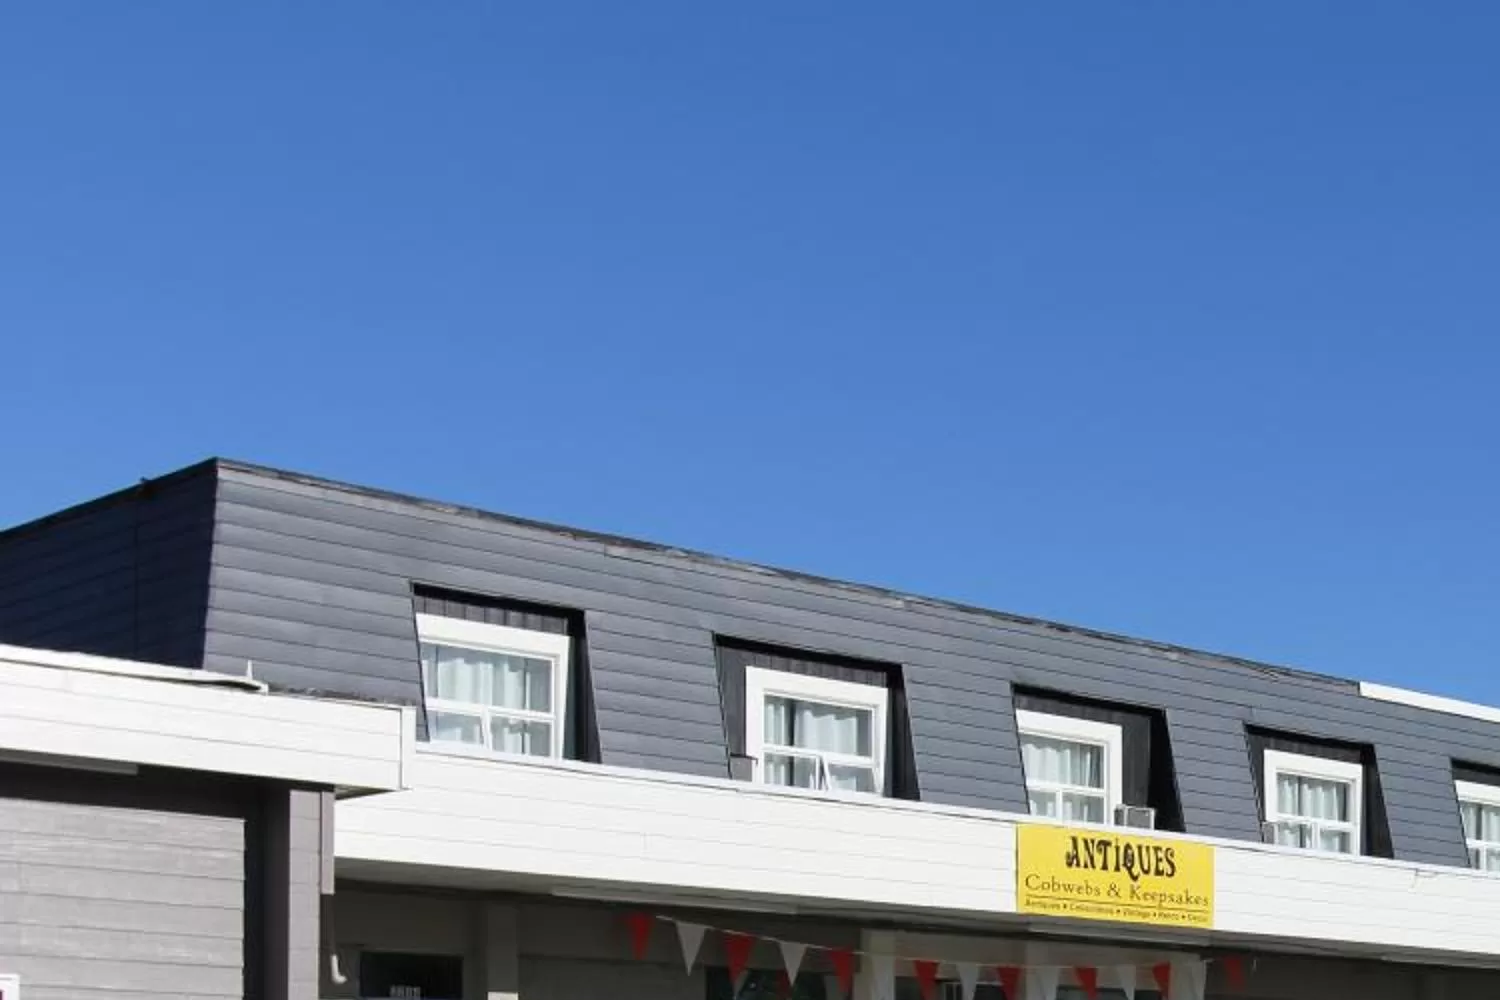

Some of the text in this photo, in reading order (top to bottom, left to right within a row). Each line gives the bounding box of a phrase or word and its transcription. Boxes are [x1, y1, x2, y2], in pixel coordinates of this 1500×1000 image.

[1066, 836, 1176, 881] ANTIQUES
[1025, 874, 1209, 909] Cobwebs & Keepsakes
